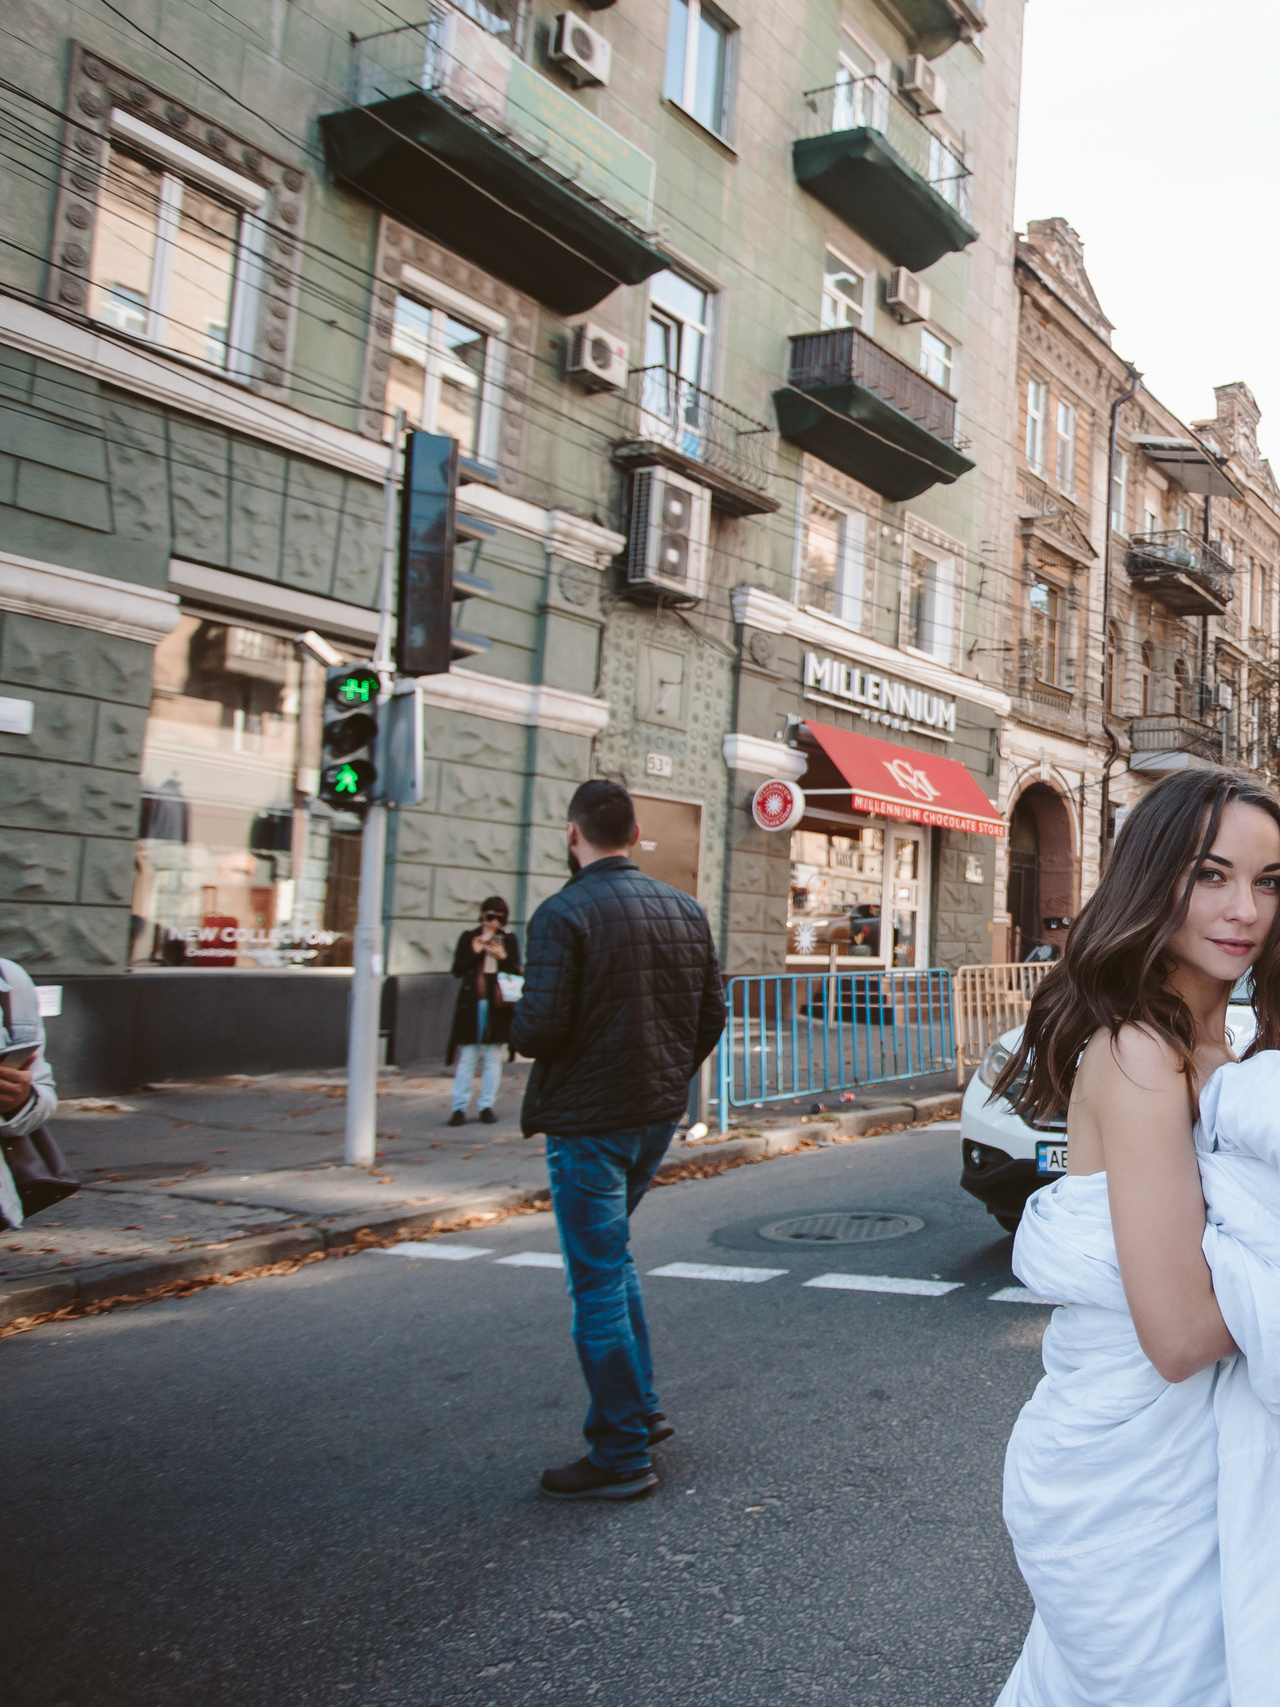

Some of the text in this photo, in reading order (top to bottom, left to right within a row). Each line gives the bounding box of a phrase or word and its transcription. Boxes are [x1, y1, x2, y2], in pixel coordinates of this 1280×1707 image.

[804, 652, 957, 732] MILLENNIUM
[861, 709, 910, 732] STORE
[854, 796, 1004, 837] MILLENNIUM CHOCOLATE STORE
[168, 926, 219, 942] NEW
